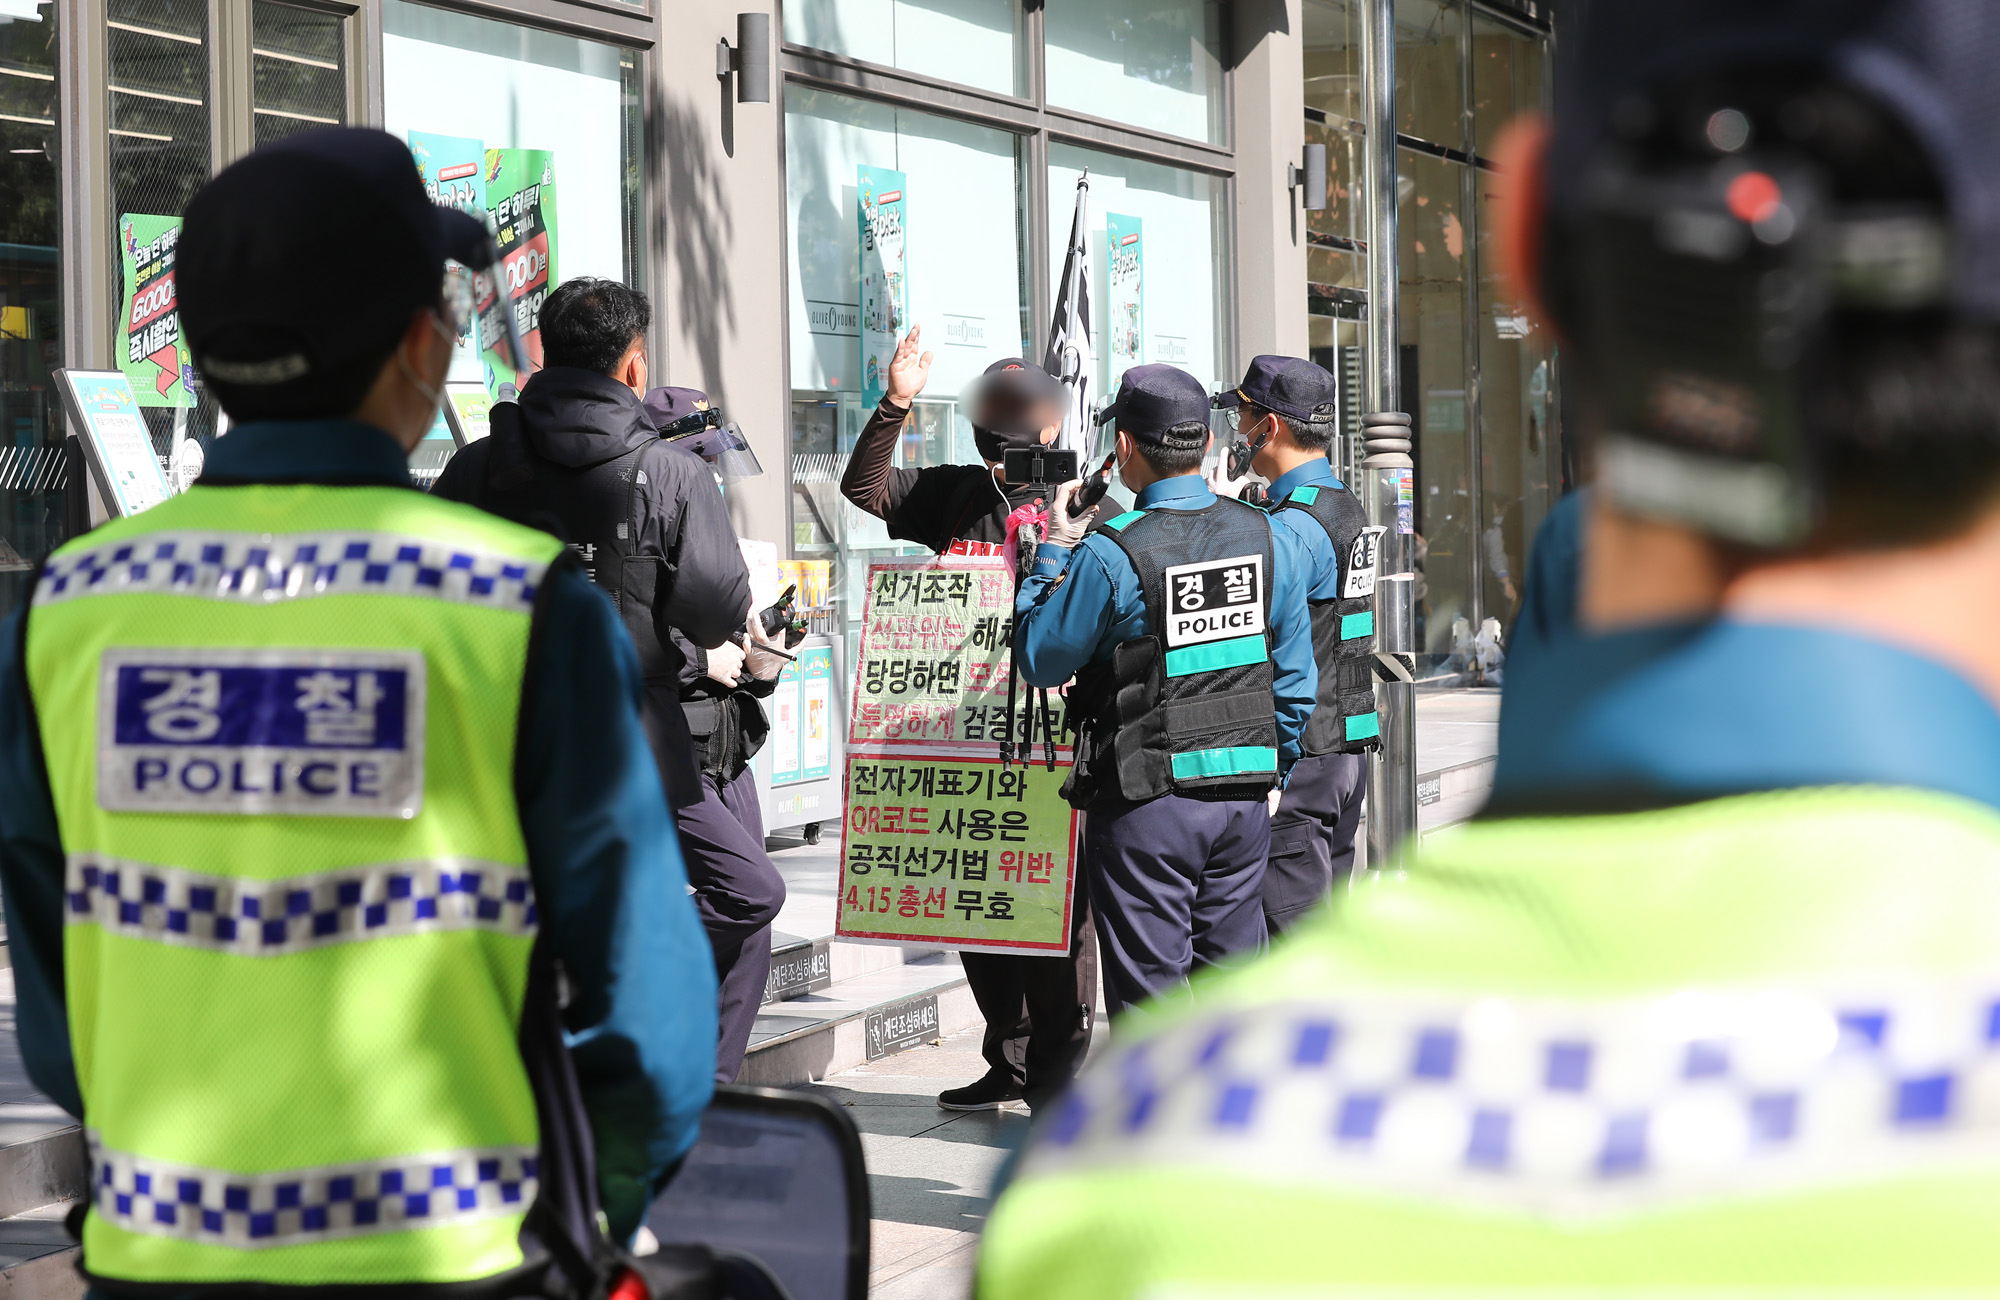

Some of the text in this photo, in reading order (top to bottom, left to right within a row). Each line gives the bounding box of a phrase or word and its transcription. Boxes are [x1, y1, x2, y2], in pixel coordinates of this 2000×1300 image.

[499, 197, 511, 225] 단
[512, 183, 541, 217] 하루!
[135, 225, 179, 269] 오늘 단 하루!
[129, 310, 179, 364] 즉시할인
[812, 311, 857, 327] OLIVE YOUNG
[947, 323, 983, 339] OLIVE YOUNG
[1166, 437, 1200, 449] POLICE
[1354, 534, 1377, 568] 경찰
[876, 572, 973, 607] 선거조작
[1177, 566, 1253, 610] 경찰
[1350, 573, 1373, 590] POLICE
[871, 615, 966, 650] 선관위는
[1178, 611, 1254, 636] POLICE
[866, 658, 961, 695] 당당하면
[140, 670, 385, 745] 경찰
[859, 702, 957, 739] 투명하게
[134, 757, 380, 797] POLICE
[854, 765, 1028, 802] 전자개표기와
[777, 795, 820, 814] OLIVE YOUNG
[851, 805, 1029, 842] QR코드 사용은
[849, 844, 1055, 884] 공직선거법 위반
[845, 885, 1015, 921] 4.15 총선 무효
[772, 951, 829, 988] 계단조심하세요!
[884, 1003, 937, 1040] 계단조심하세요!
